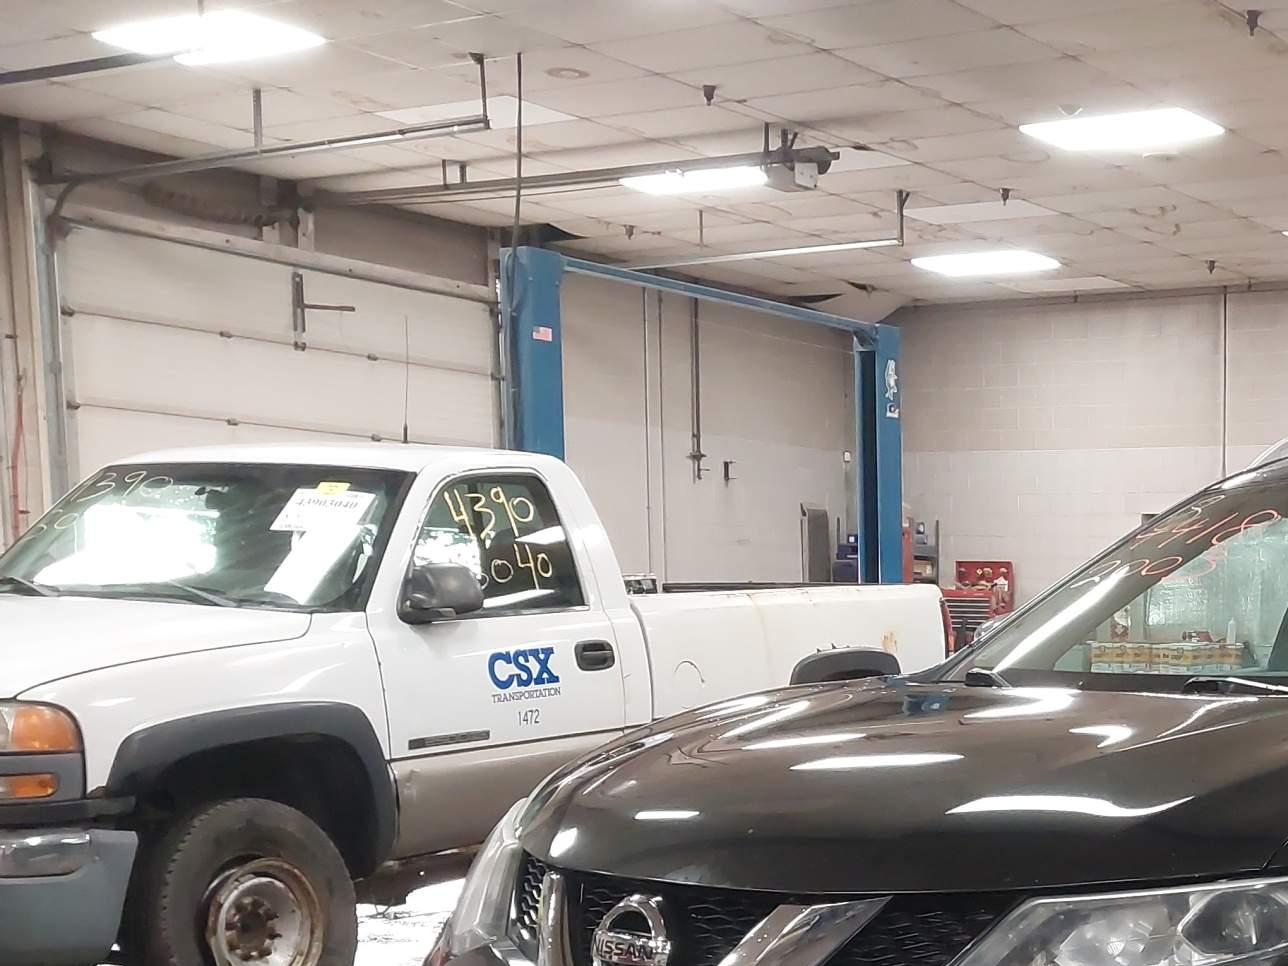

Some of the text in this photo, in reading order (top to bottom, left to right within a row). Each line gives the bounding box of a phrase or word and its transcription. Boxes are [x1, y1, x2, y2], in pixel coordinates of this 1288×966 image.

[444, 486, 534, 540] 4390
[487, 646, 561, 690] CSX
[491, 686, 562, 704] TRANSPORTATION
[517, 708, 541, 726] 1472
[593, 938, 654, 962] NISSAN
